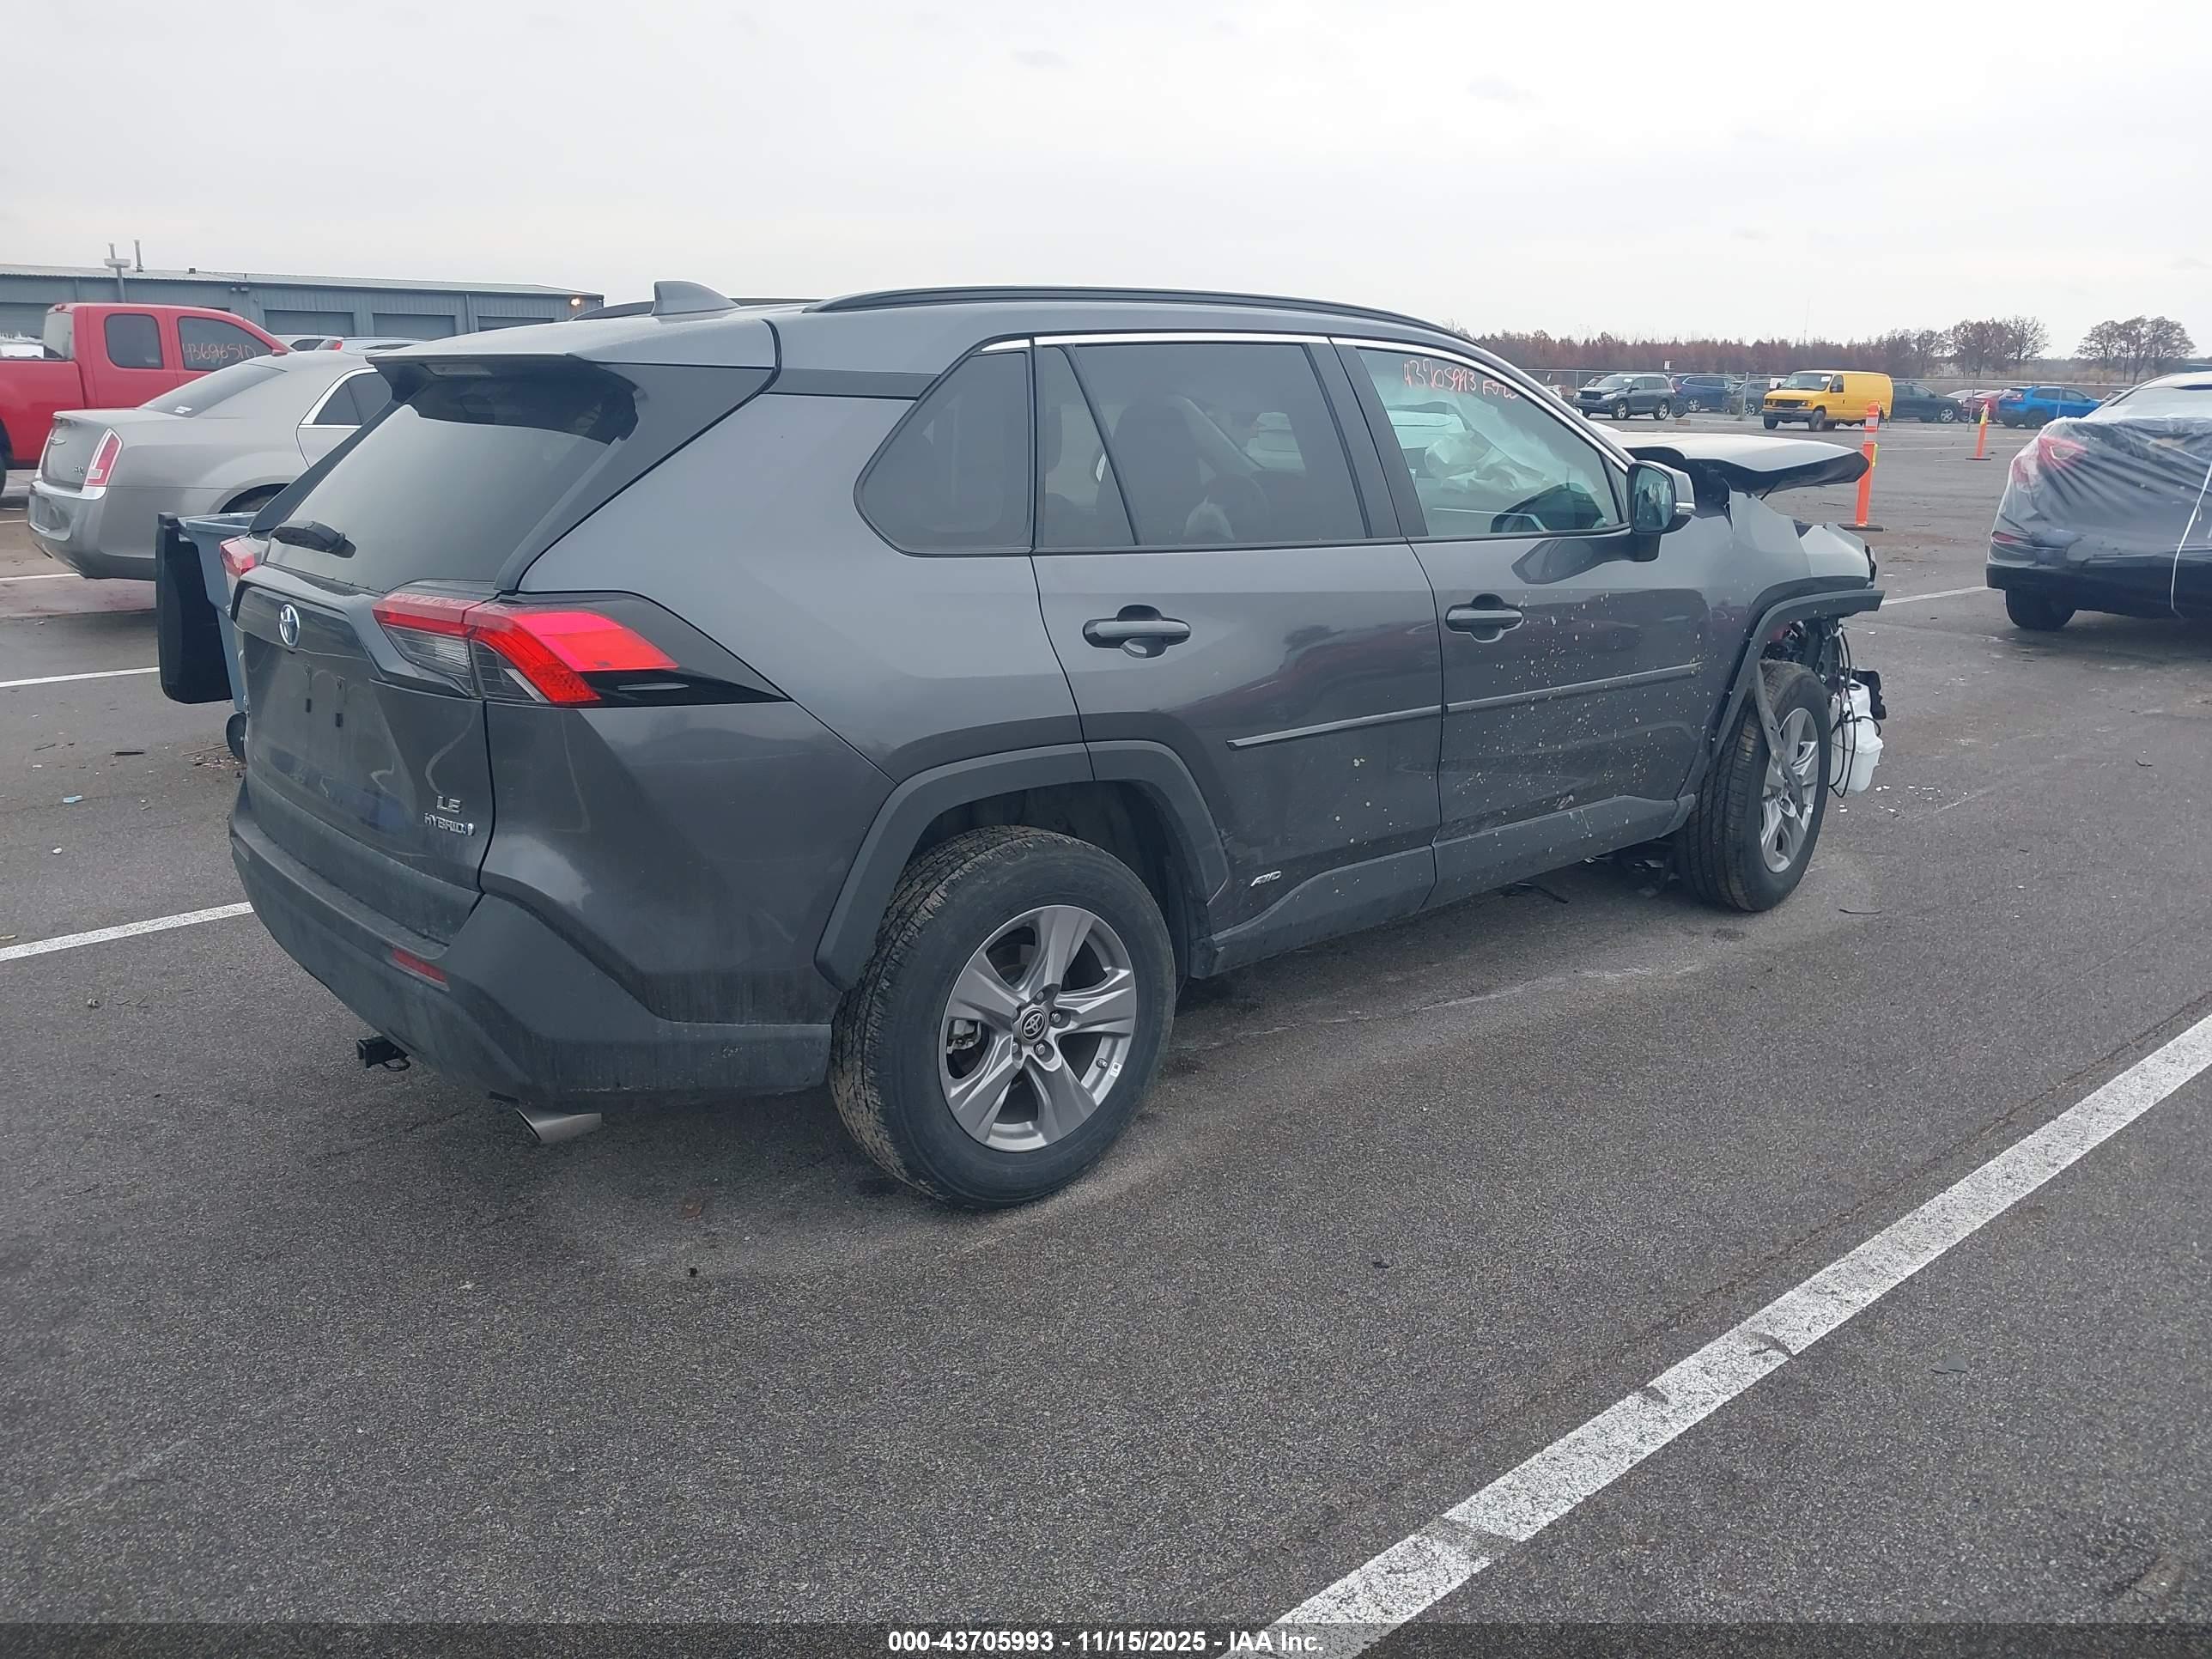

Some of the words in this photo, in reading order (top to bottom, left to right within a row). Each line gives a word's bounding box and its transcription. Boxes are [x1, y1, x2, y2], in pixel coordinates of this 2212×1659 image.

[1403, 358, 1477, 392] 43705993
[436, 795, 461, 814] LE
[424, 812, 466, 835] HYBRID
